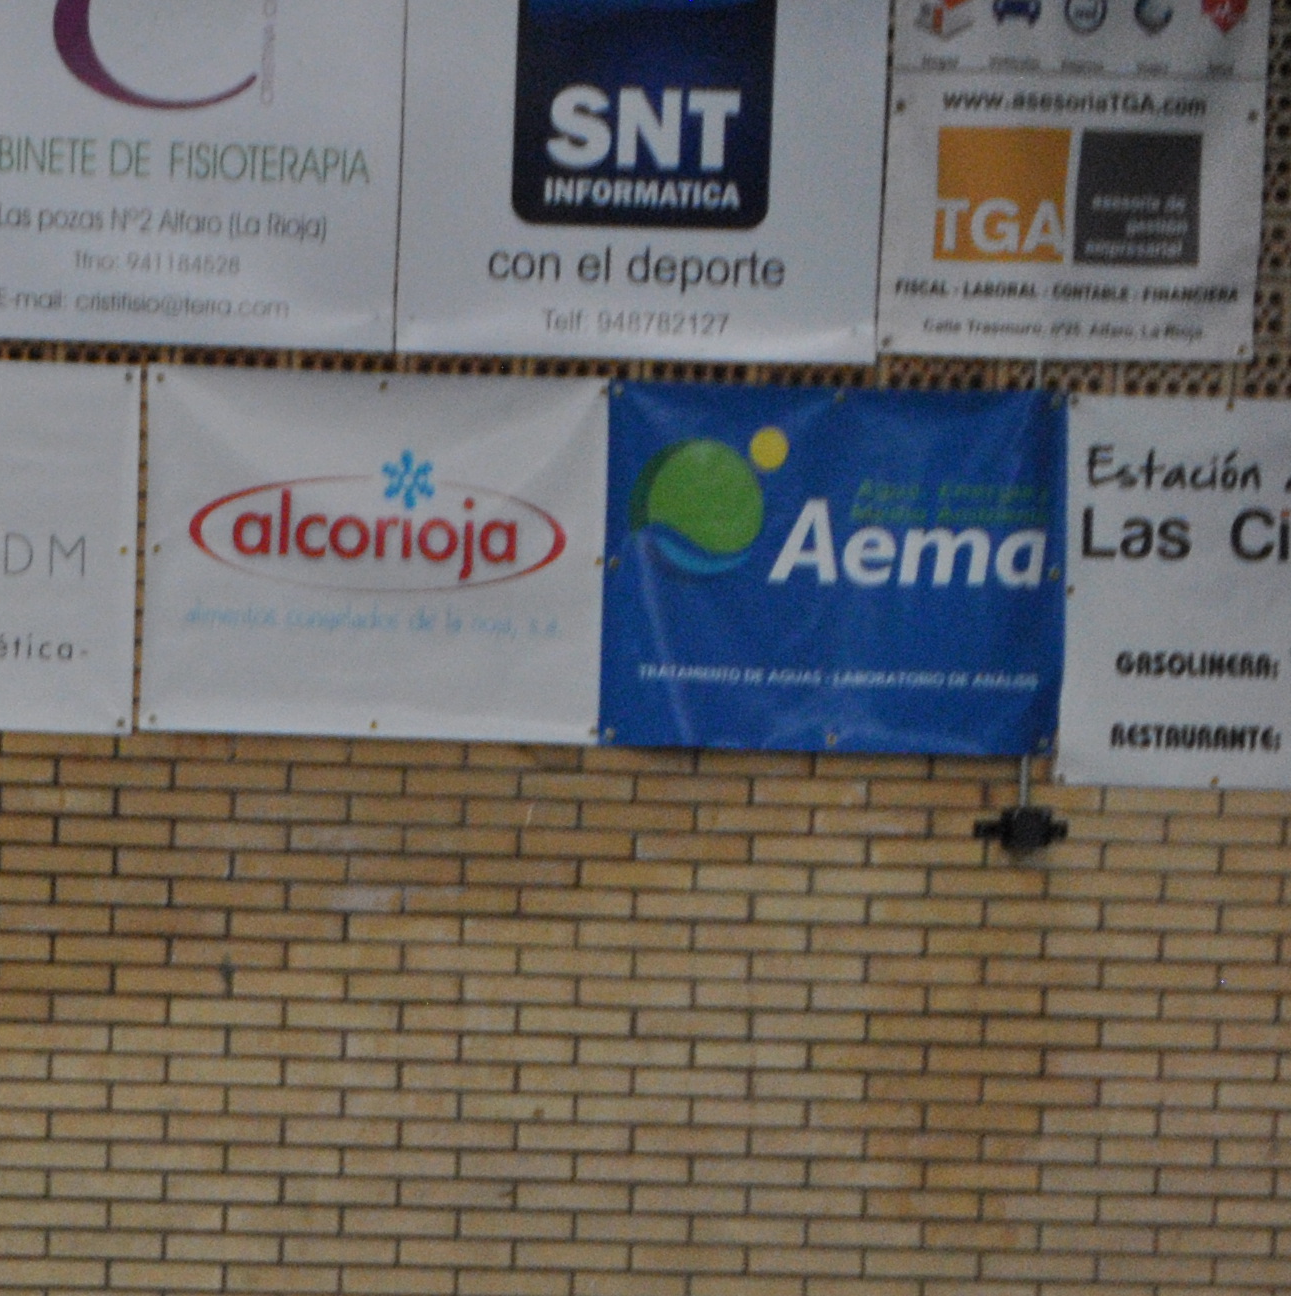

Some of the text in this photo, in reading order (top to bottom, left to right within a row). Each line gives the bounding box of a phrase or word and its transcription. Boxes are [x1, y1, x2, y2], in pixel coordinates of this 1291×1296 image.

[546, 83, 742, 172] SNT
[110, 137, 151, 179] DE
[169, 140, 371, 184] FISIOTERAPIA
[543, 176, 741, 211] INFORMATICA
[159, 208, 223, 235] Alfaro
[938, 197, 1065, 255] TGA
[487, 244, 786, 293] con el deporte
[1087, 443, 1262, 491] Estación
[3, 531, 87, 578] DM
[232, 488, 518, 581] alcorioja
[768, 496, 1048, 589] Aema
[1082, 506, 1192, 561] Las
